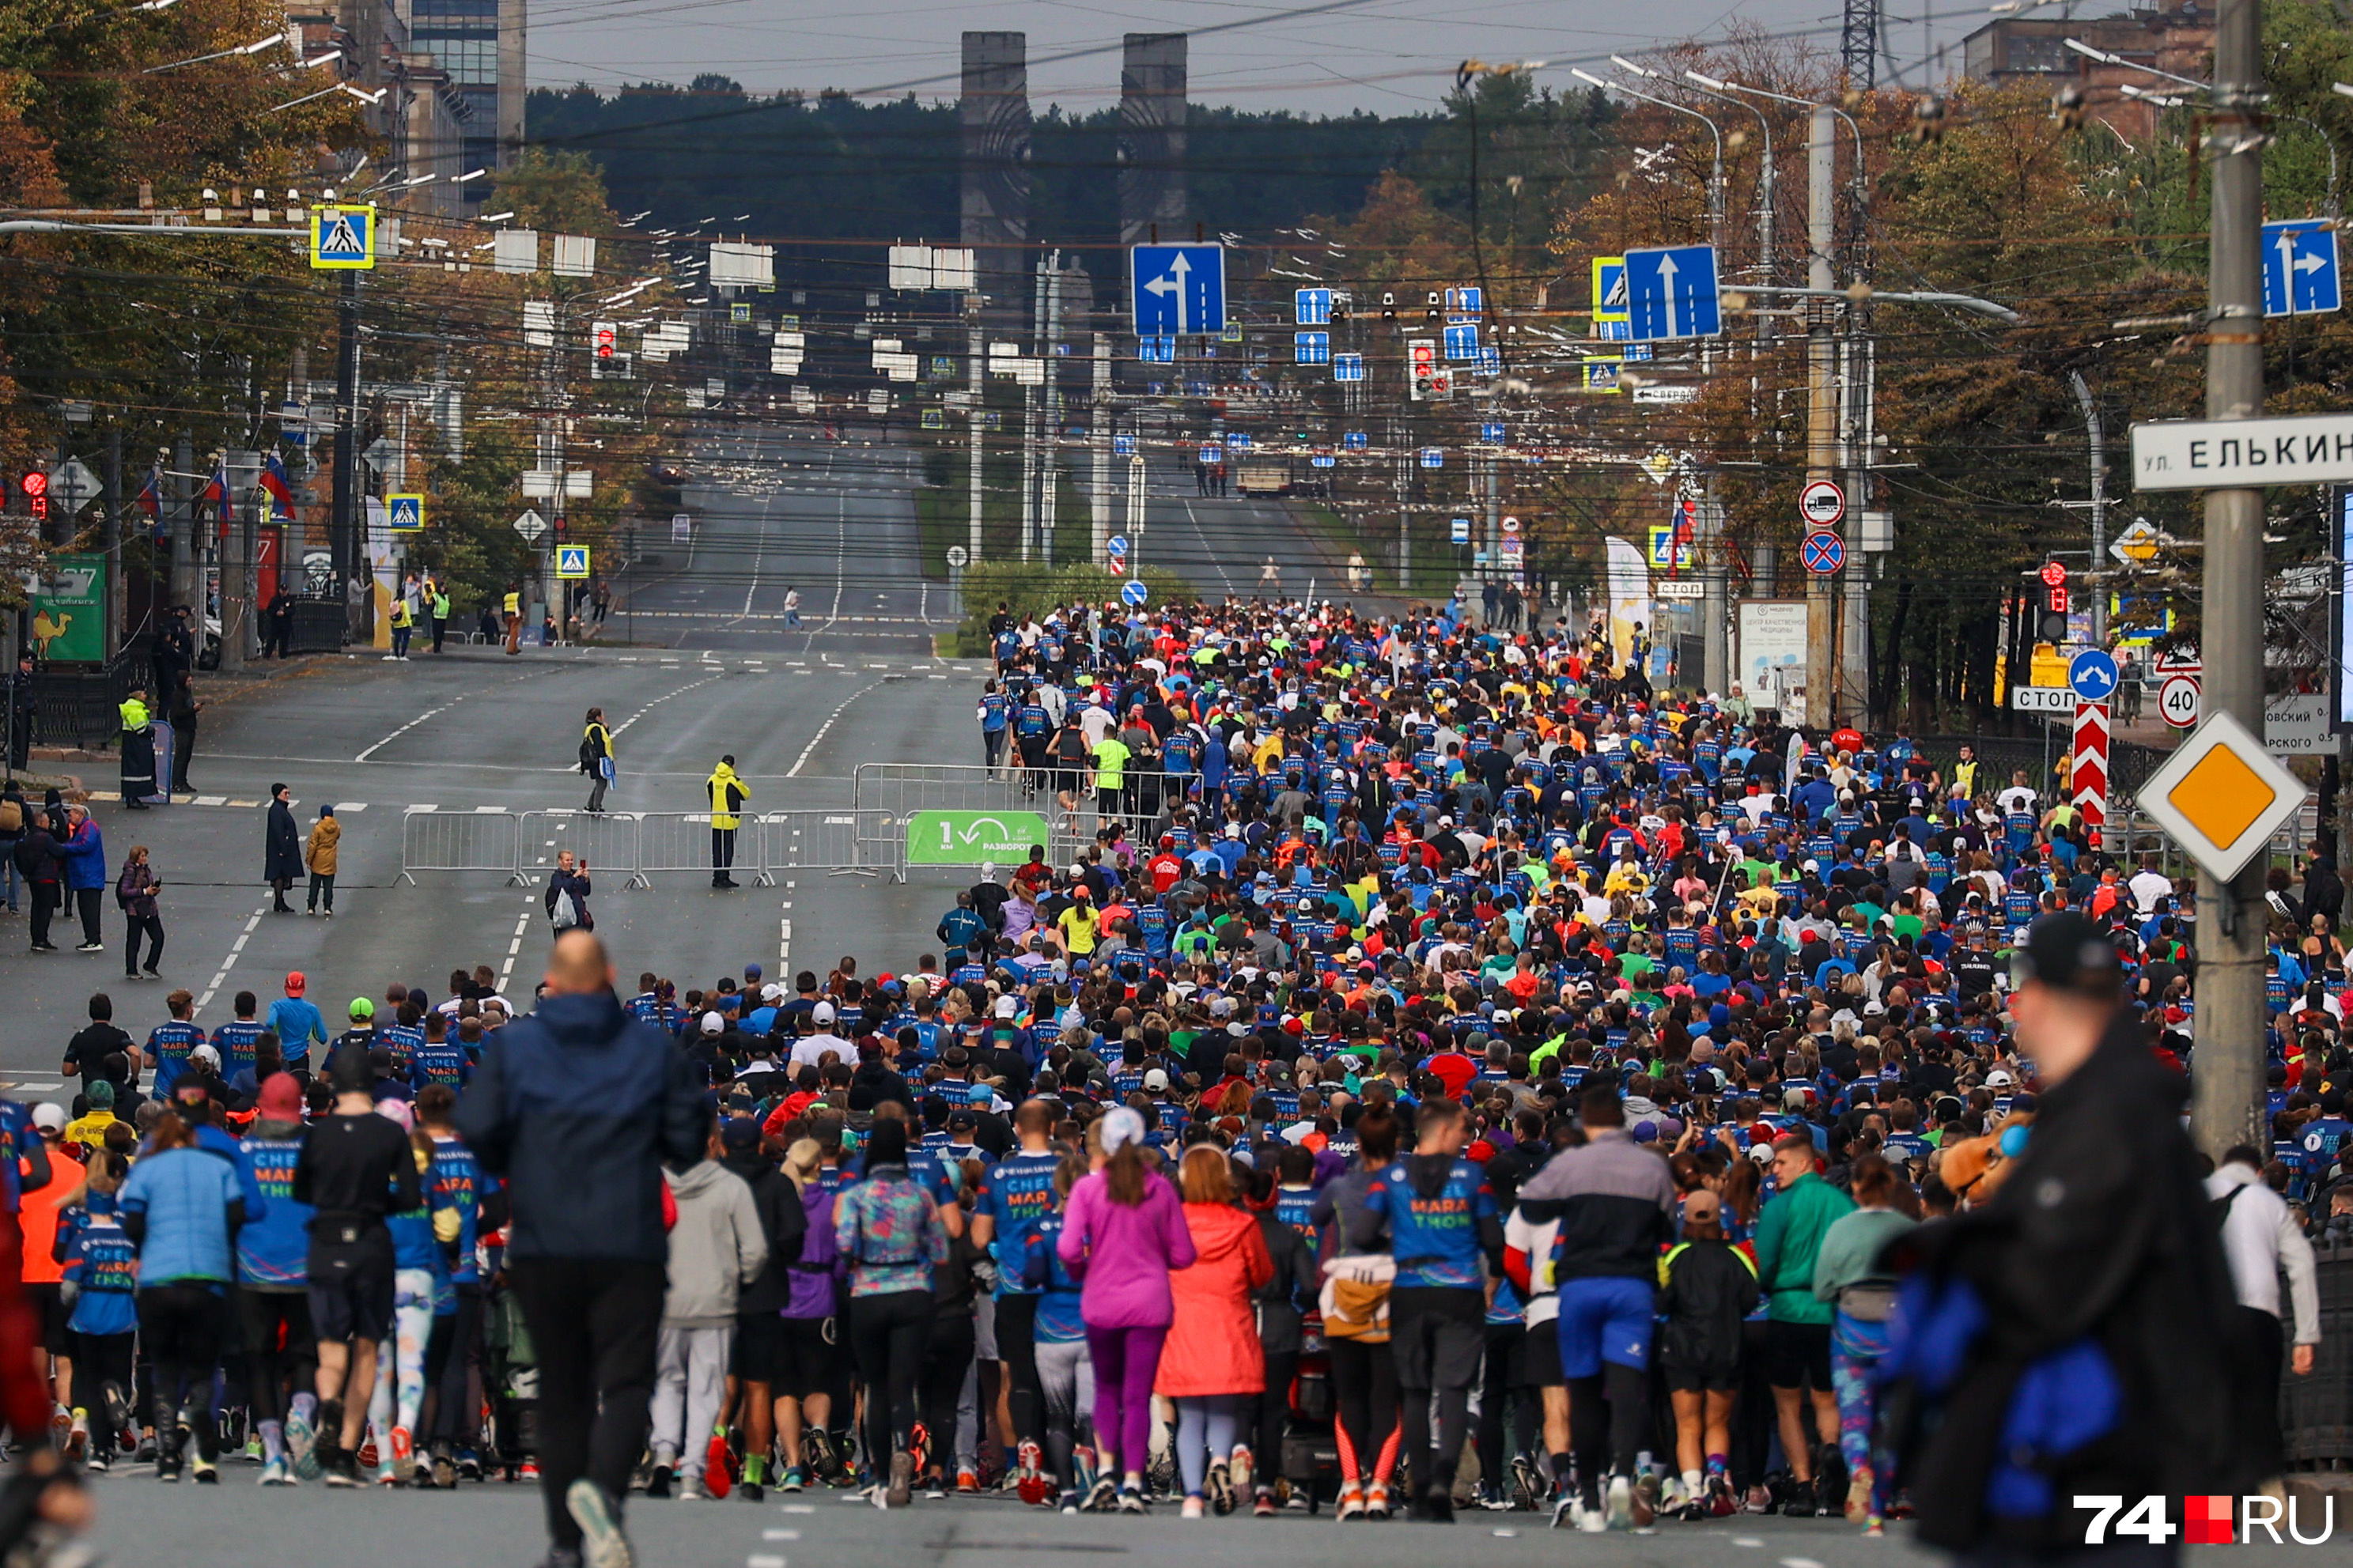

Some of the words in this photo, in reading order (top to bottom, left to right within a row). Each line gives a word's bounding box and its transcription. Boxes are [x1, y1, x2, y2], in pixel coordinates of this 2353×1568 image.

[1662, 584, 1699, 594] СТОП
[2019, 691, 2076, 708] СТОП
[2167, 690, 2193, 711] 40
[2266, 711, 2310, 723] ОВСКИЙ
[940, 822, 950, 844] 1
[391, 1035, 419, 1048] CHEL
[254, 1151, 296, 1167] CHE
[1007, 1191, 1048, 1206] MAR
[1411, 1199, 1470, 1213] MARA
[1412, 1214, 1471, 1229] THON
